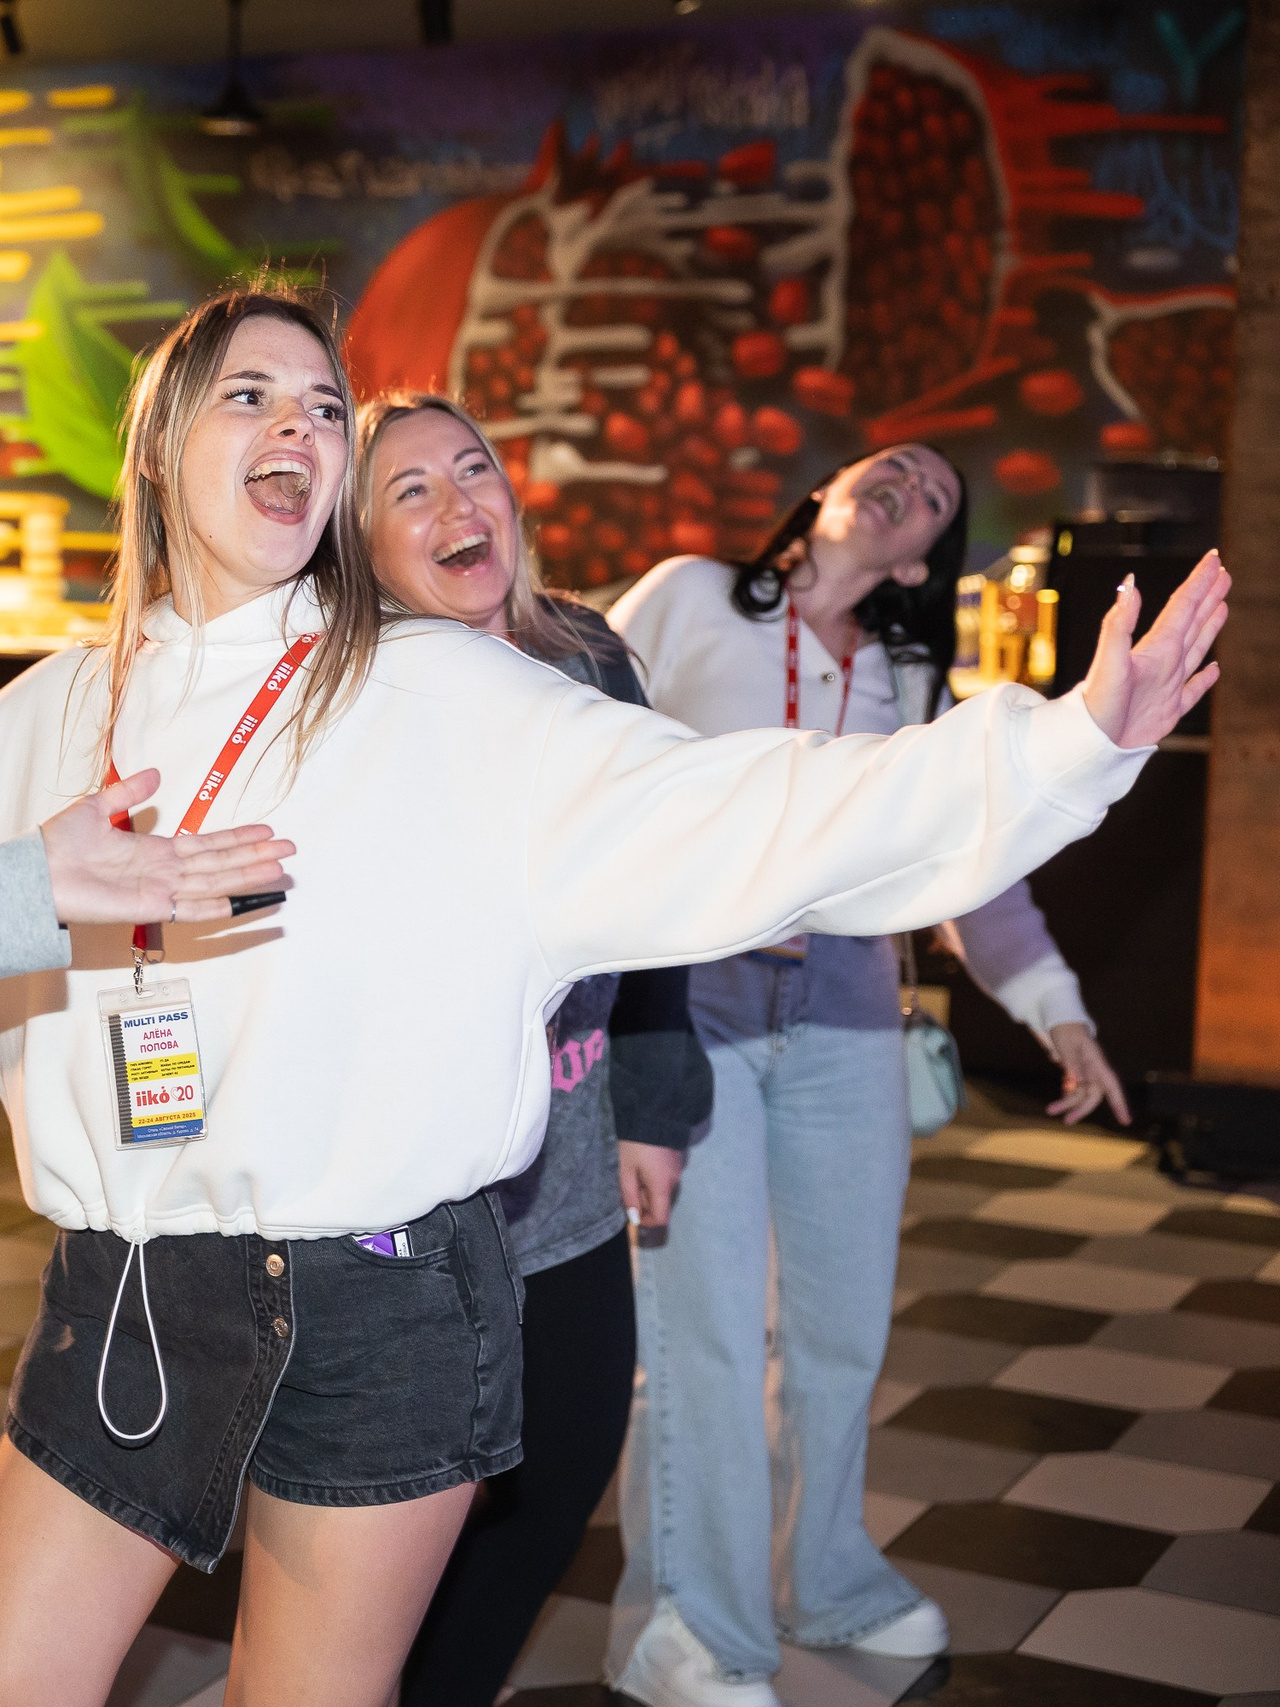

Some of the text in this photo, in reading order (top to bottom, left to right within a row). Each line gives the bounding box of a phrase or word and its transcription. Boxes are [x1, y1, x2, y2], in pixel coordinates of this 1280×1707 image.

[124, 1011, 188, 1028] MULTI PASS
[143, 1028, 172, 1040] АЛЁНА
[140, 1040, 179, 1053] ПОПОВА
[176, 1085, 194, 1101] 20
[155, 1114, 181, 1123] АВГУСТА
